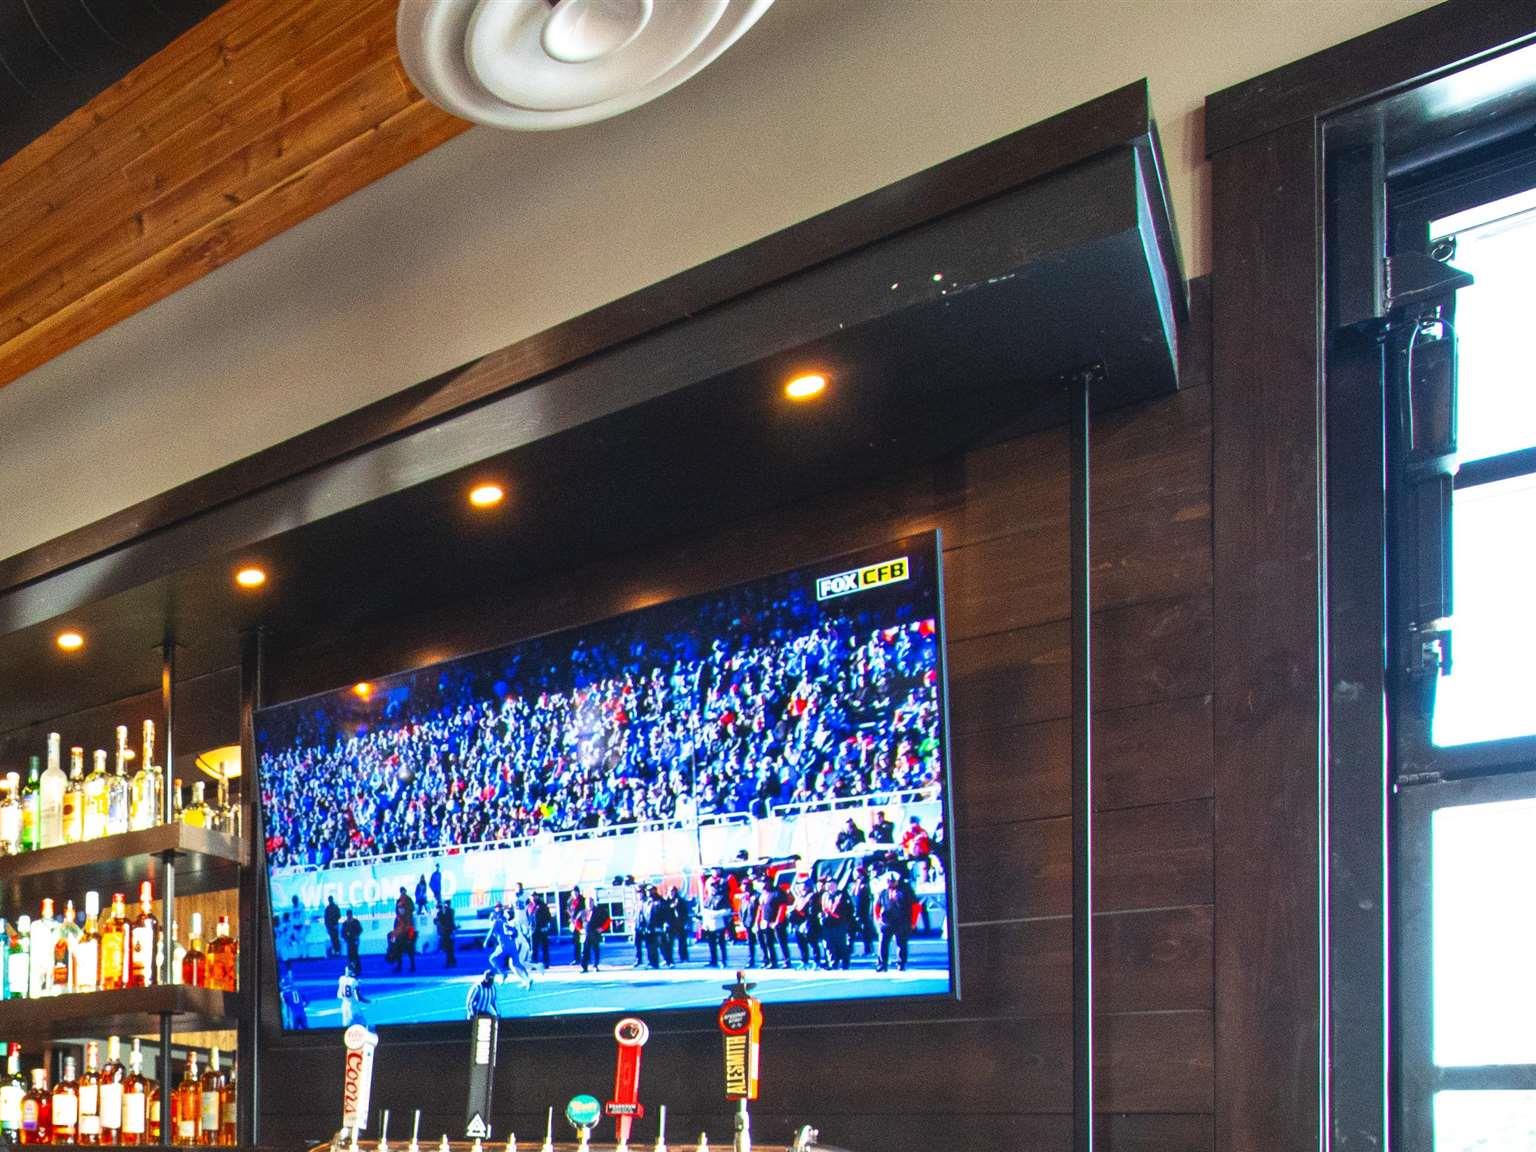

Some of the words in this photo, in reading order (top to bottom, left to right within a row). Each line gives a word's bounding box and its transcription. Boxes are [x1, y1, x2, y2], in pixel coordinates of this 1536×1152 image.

[821, 571, 858, 597] FOX
[863, 562, 904, 585] CFB
[345, 1052, 363, 1114] Coors
[726, 1035, 747, 1094] ALESMITH
